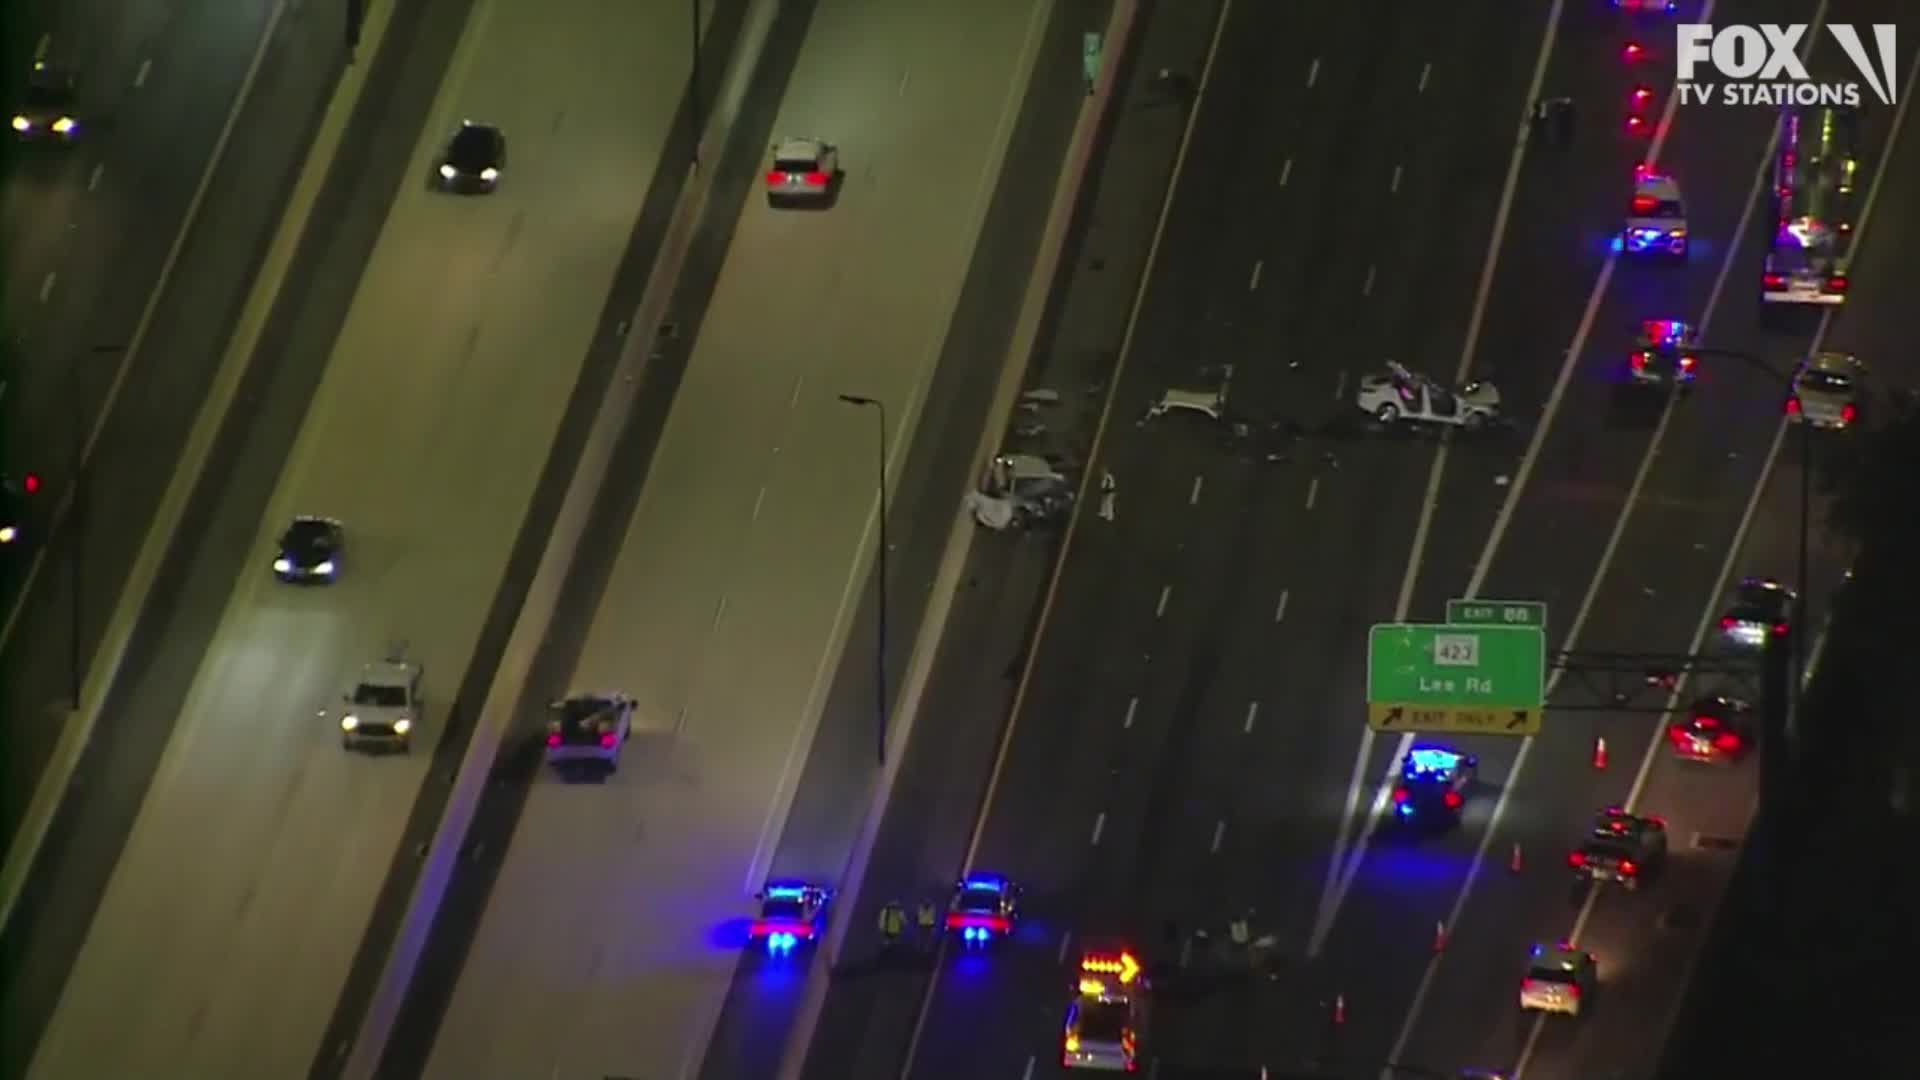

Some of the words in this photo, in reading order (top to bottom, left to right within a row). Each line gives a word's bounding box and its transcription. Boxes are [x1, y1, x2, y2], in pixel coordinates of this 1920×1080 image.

[1463, 607, 1494, 619] EXIT
[1419, 676, 1455, 693] Lee
[1465, 676, 1493, 694] Rd
[1412, 710, 1446, 724] EXIT
[1455, 711, 1498, 726] ONLY
